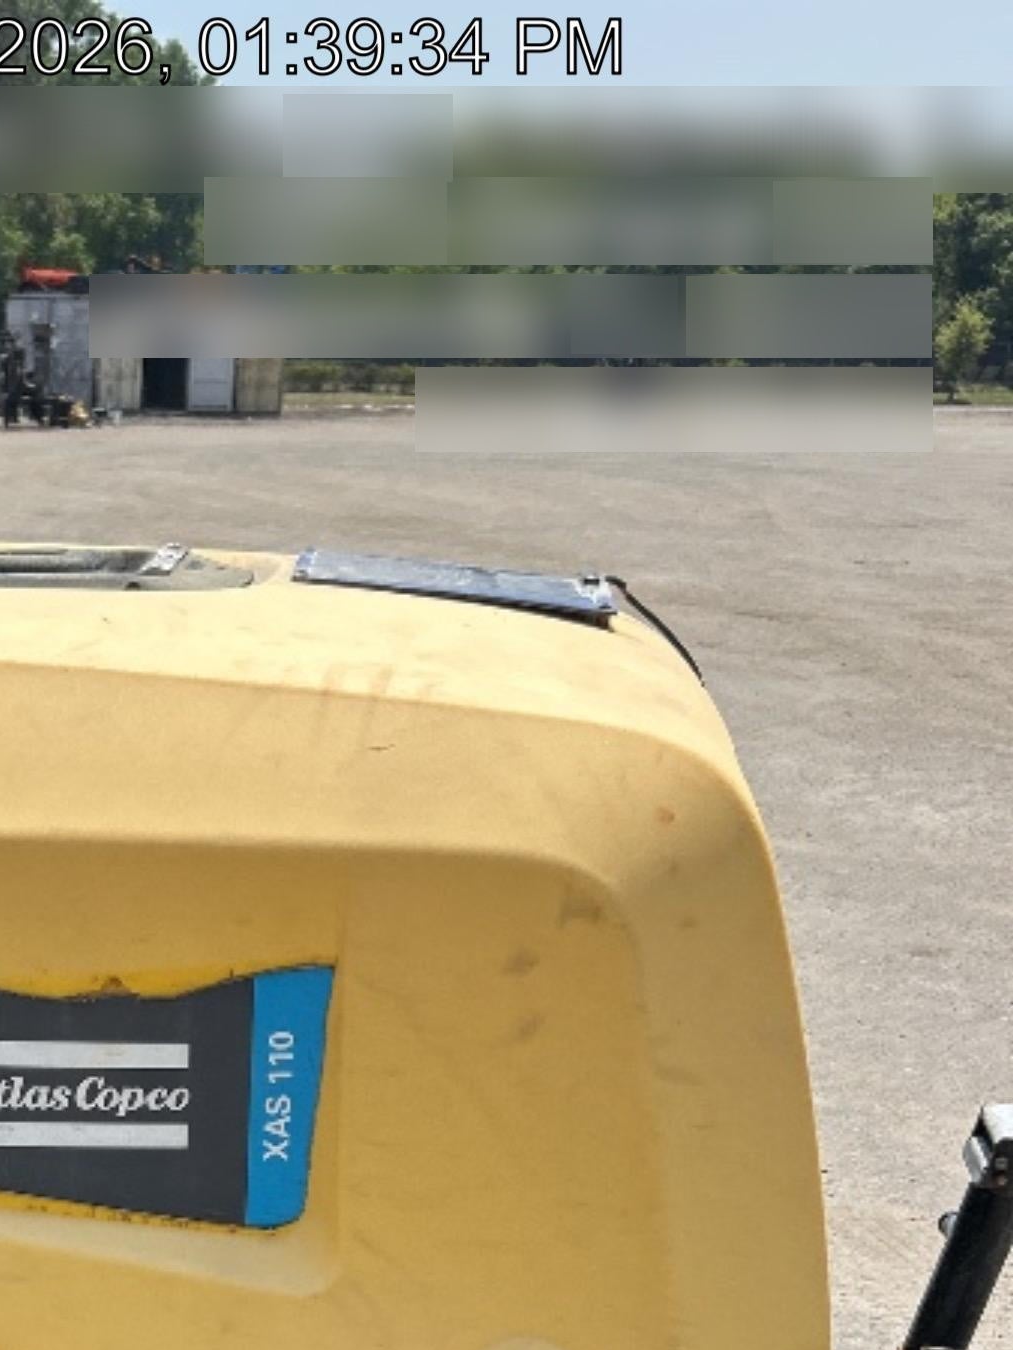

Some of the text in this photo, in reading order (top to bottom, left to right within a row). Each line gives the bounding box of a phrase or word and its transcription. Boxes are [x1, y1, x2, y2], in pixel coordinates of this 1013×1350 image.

[75, 1076, 190, 1117] Copco
[262, 1031, 294, 1161] XAS 110
